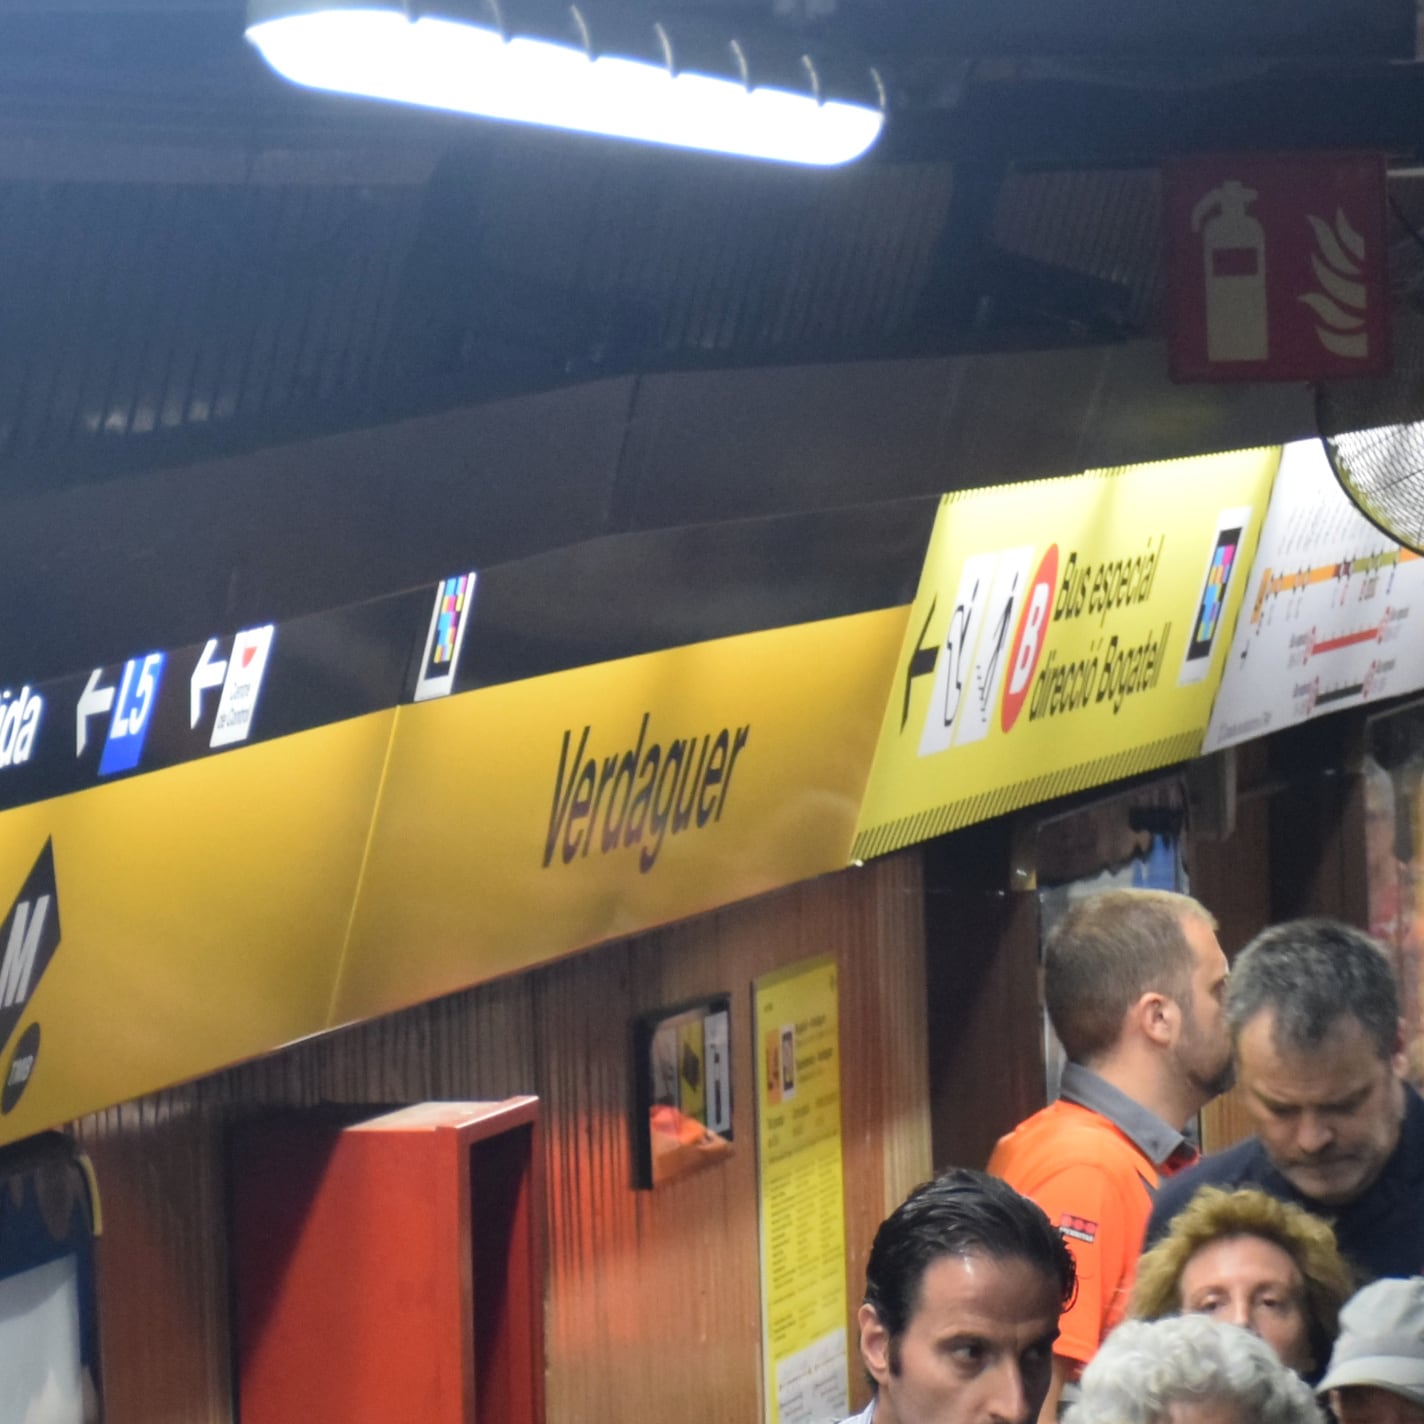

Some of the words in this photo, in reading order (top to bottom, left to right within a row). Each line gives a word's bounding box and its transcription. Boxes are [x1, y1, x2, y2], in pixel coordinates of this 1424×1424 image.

[1053, 552, 1091, 622] Bus
[1087, 533, 1166, 629] especial
[109, 652, 161, 740] L5
[1028, 636, 1104, 723] direcció
[1095, 621, 1173, 716] Bogatell
[541, 711, 751, 875] Verdaguer
